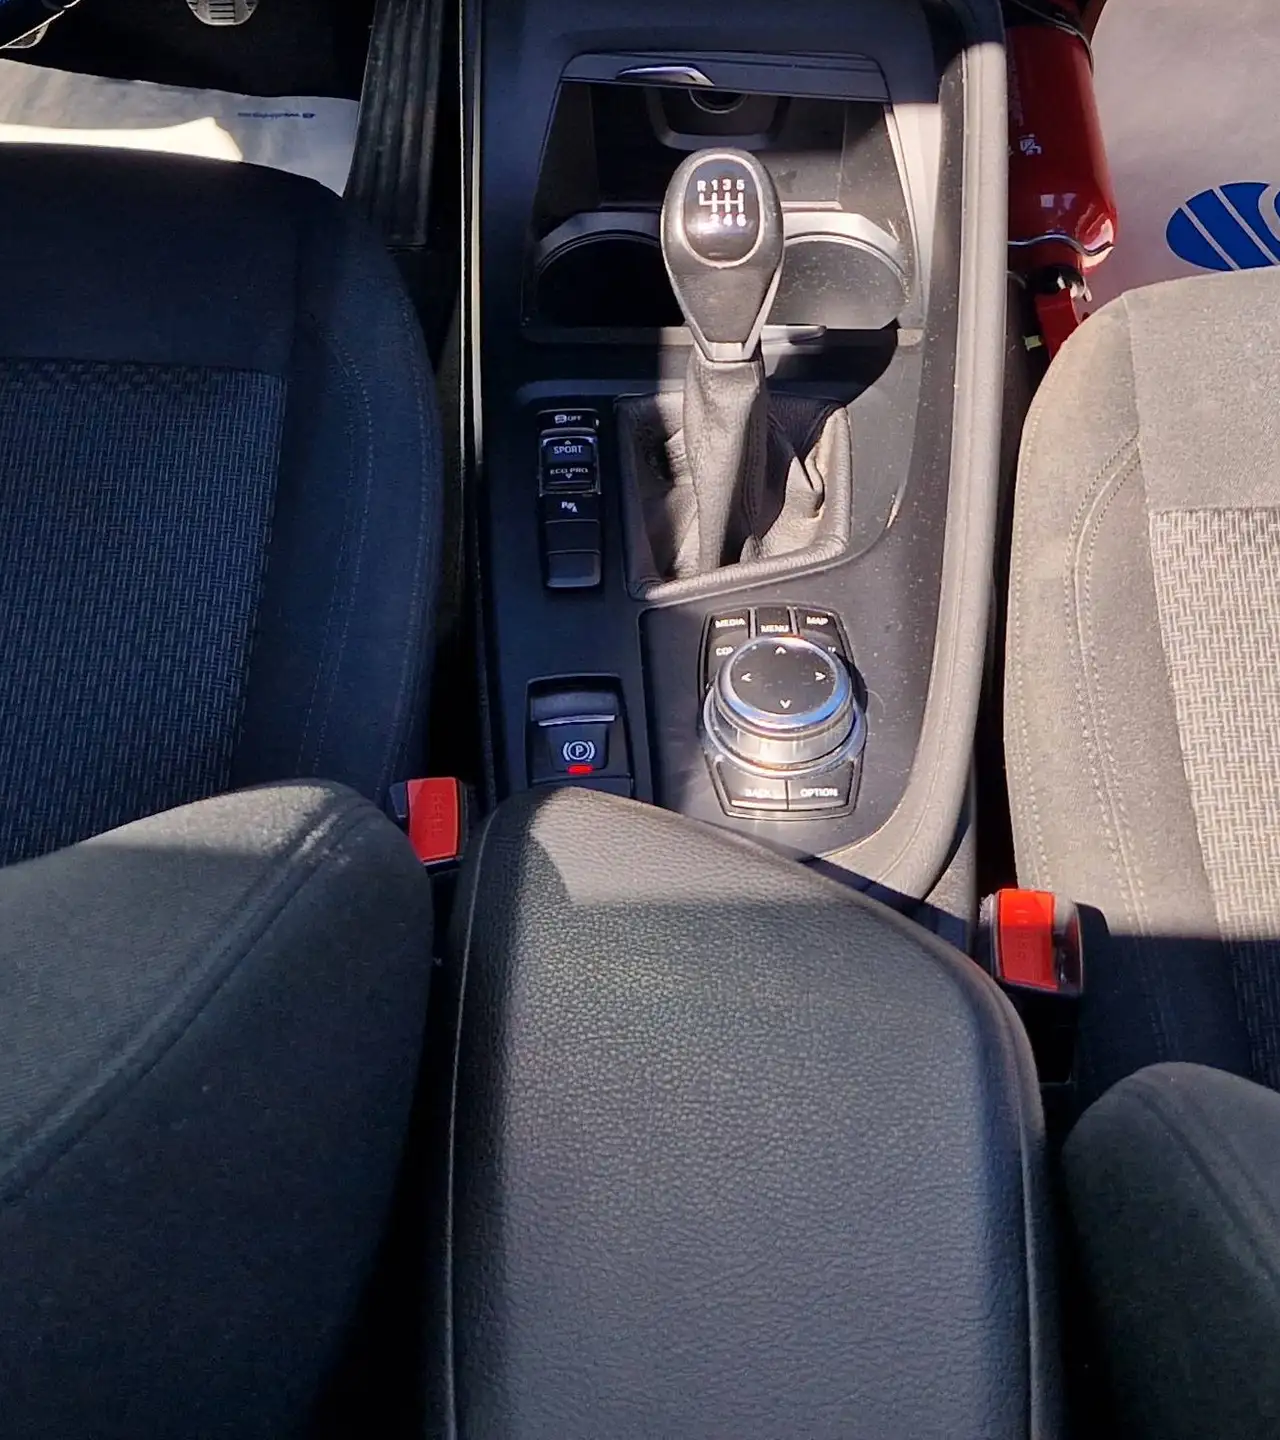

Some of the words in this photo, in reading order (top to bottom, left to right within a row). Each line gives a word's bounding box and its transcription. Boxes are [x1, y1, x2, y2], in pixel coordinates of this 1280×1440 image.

[697, 180, 706, 192] R
[711, 179, 718, 191] 1
[722, 178, 731, 191] 3
[736, 179, 745, 191] 5
[723, 214, 733, 226] 4
[554, 445, 583, 455] SPORT
[806, 616, 828, 626] MAP
[761, 624, 789, 633] MENU
[800, 787, 838, 797] OPTION
